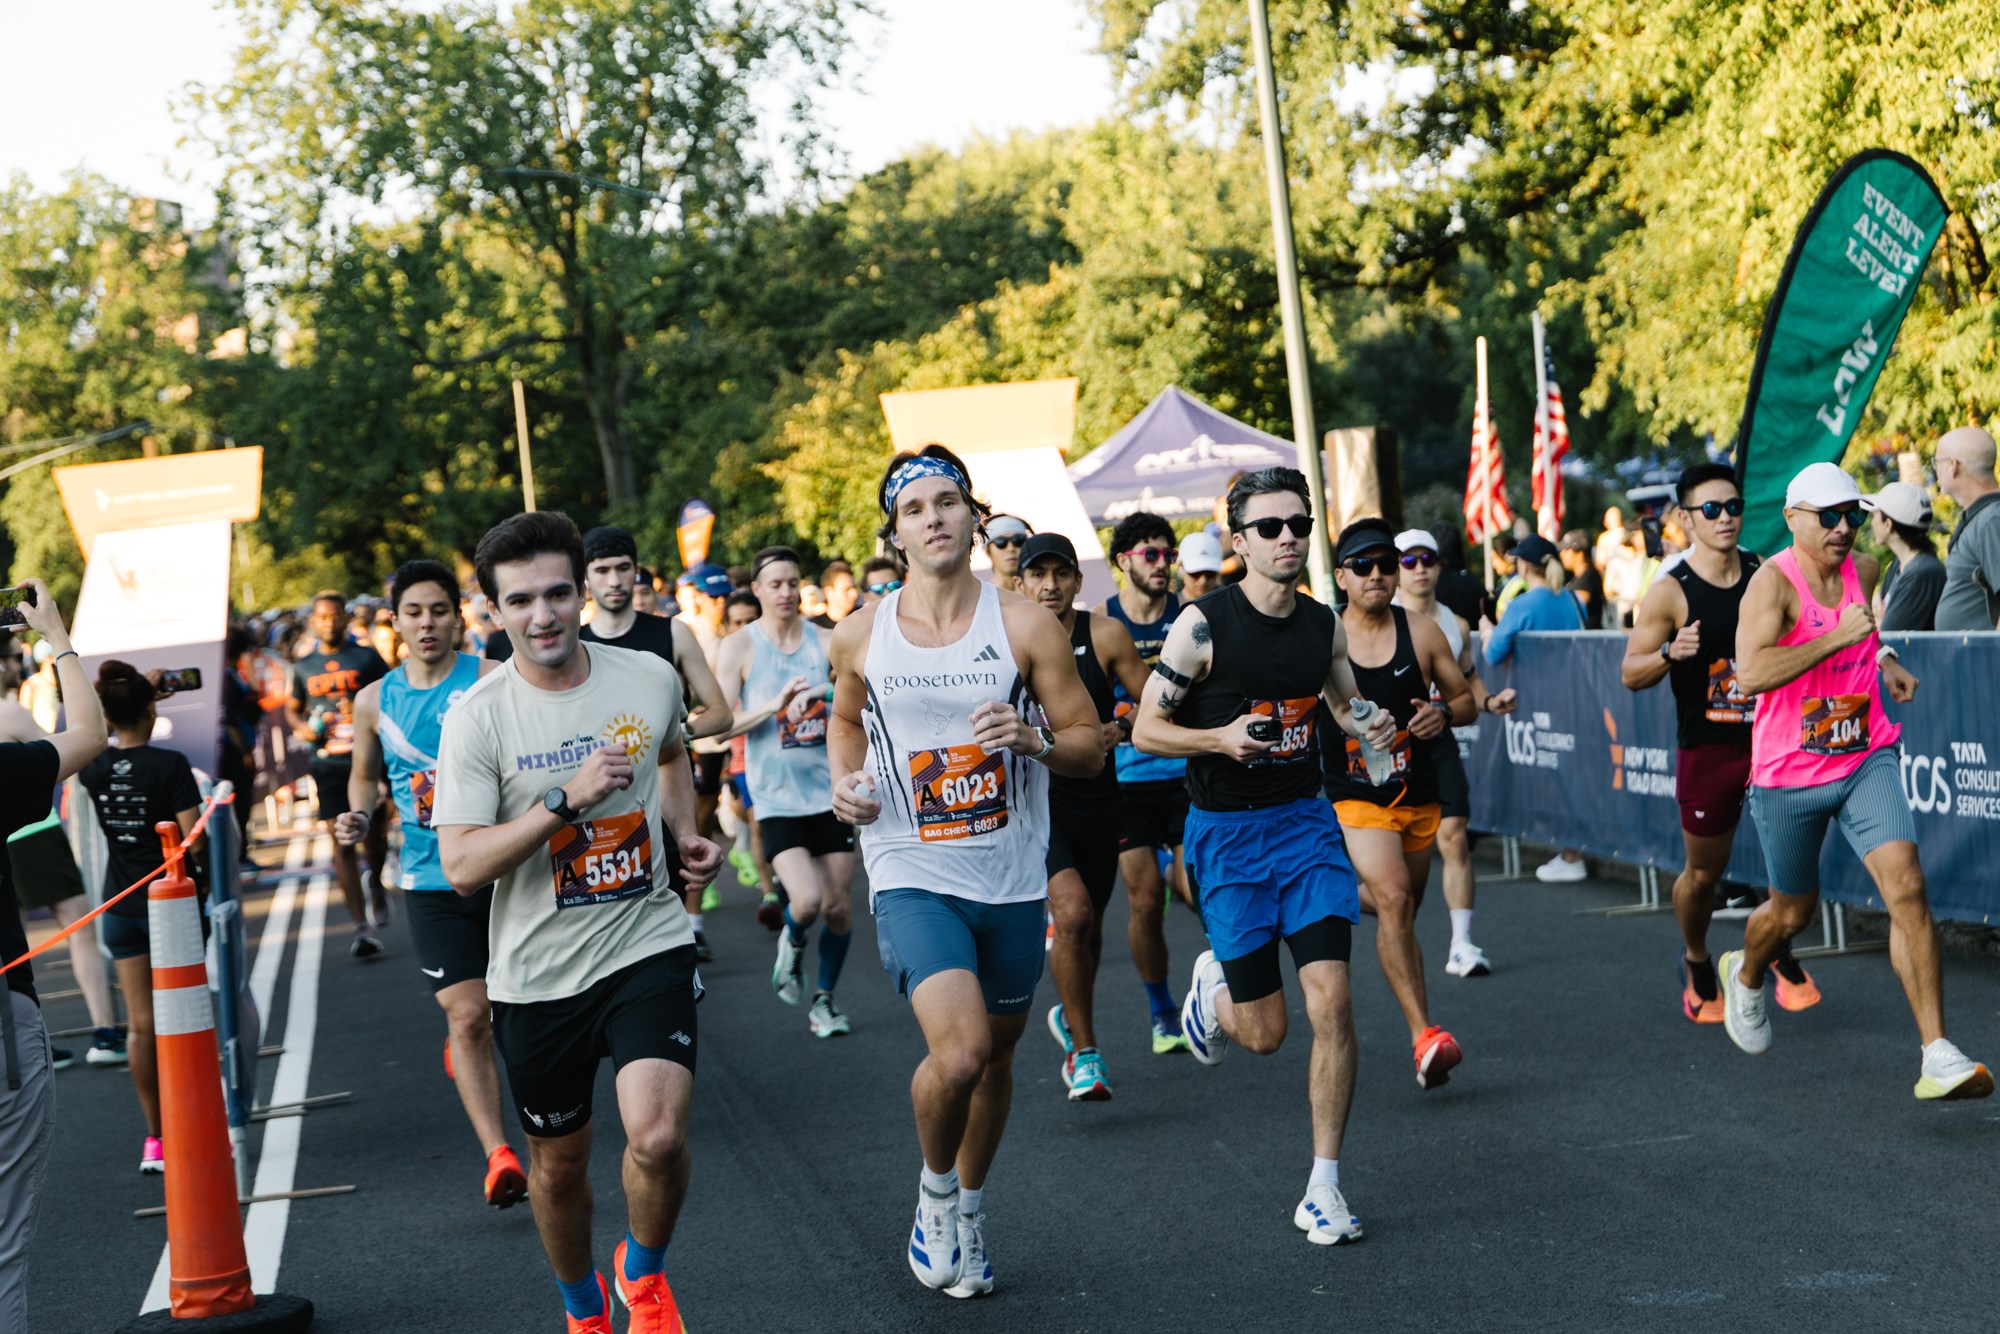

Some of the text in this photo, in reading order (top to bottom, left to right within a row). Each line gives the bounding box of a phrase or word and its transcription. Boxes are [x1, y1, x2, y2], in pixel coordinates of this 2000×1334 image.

[1863, 181, 1925, 251] EVENT
[1853, 212, 1920, 275] ALERT
[1816, 318, 1878, 437] LOW
[883, 673, 998, 695] goosetown
[1270, 724, 1308, 752] 853
[1505, 713, 1535, 765] tcs
[1830, 717, 1861, 743] 104
[1624, 745, 1643, 768] NEW
[1951, 741, 1987, 765] TATA
[921, 771, 999, 807] A 6023
[1900, 740, 1951, 815] tcs
[924, 817, 998, 838] BAG CHECK 6023
[560, 846, 644, 889] A 5531
[998, 994, 1030, 1004] BROOKS
